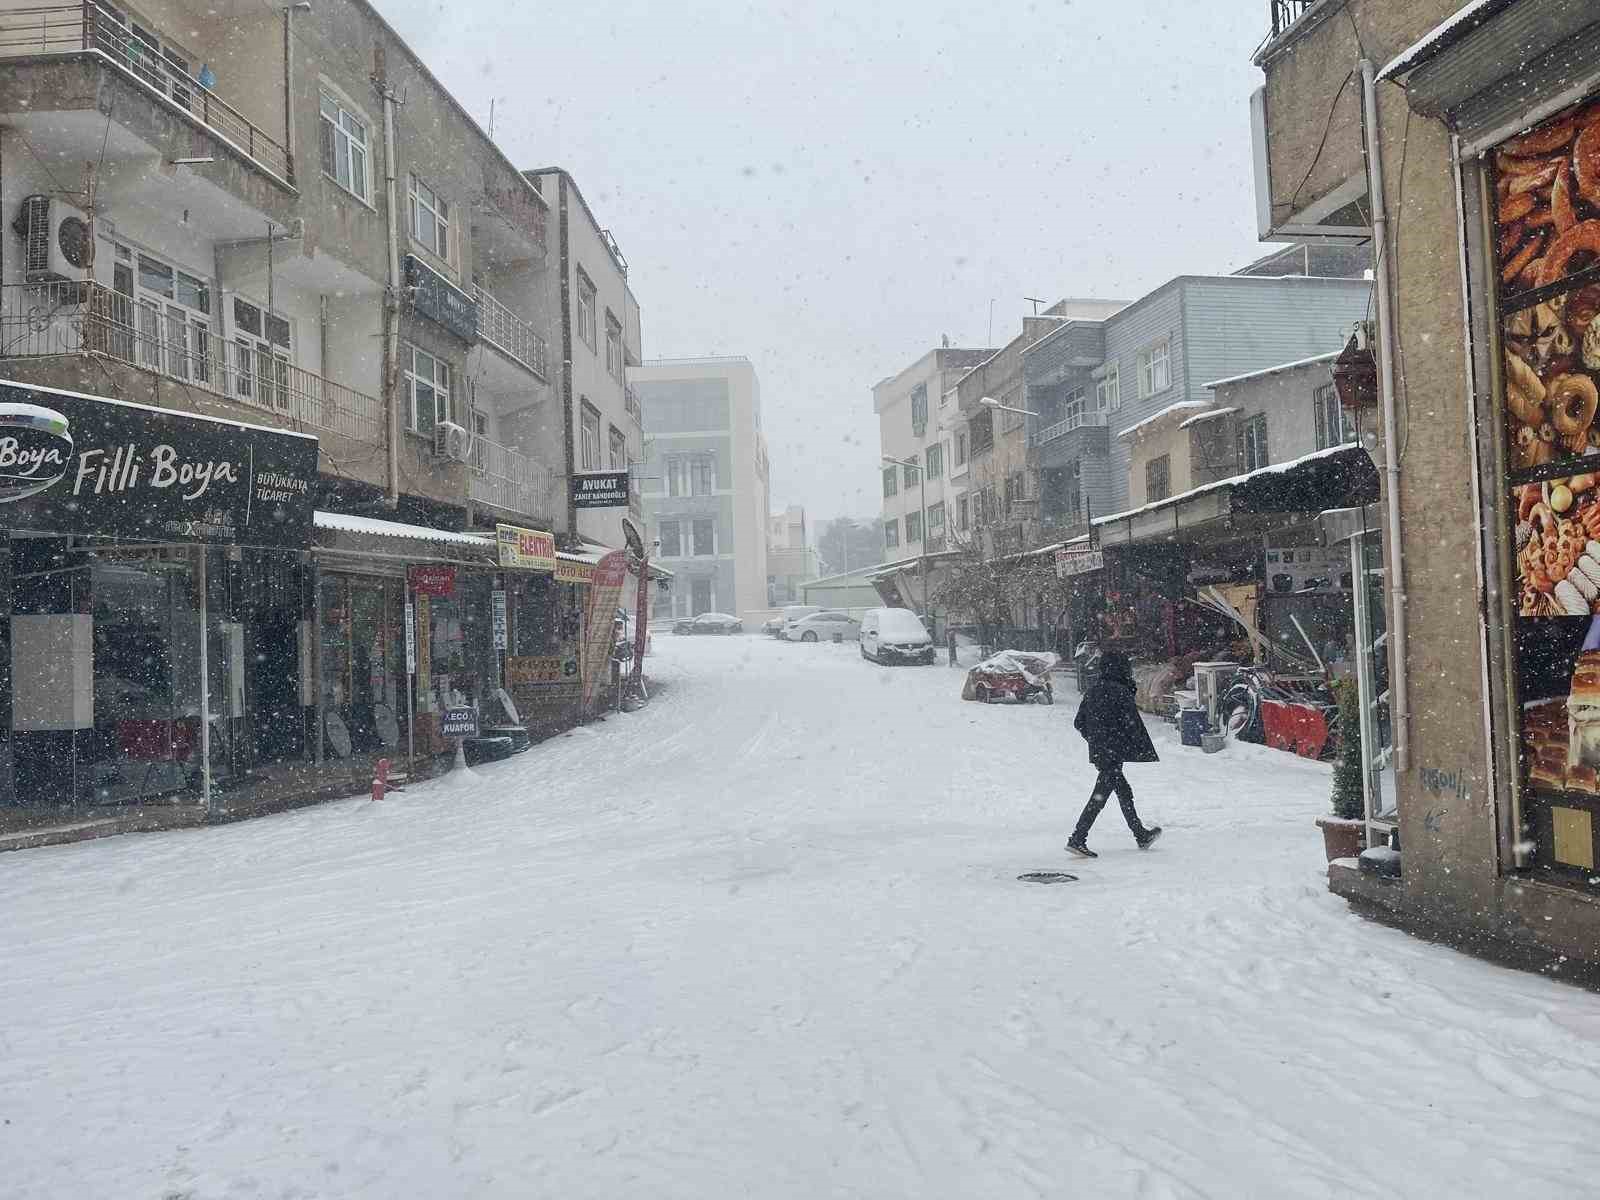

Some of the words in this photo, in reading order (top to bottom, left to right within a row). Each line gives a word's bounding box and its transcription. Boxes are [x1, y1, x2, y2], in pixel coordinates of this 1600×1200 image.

[72, 443, 139, 496] Filli
[150, 444, 238, 500] Boya
[582, 479, 617, 490] AVUKAT
[256, 486, 294, 503] TİCARET
